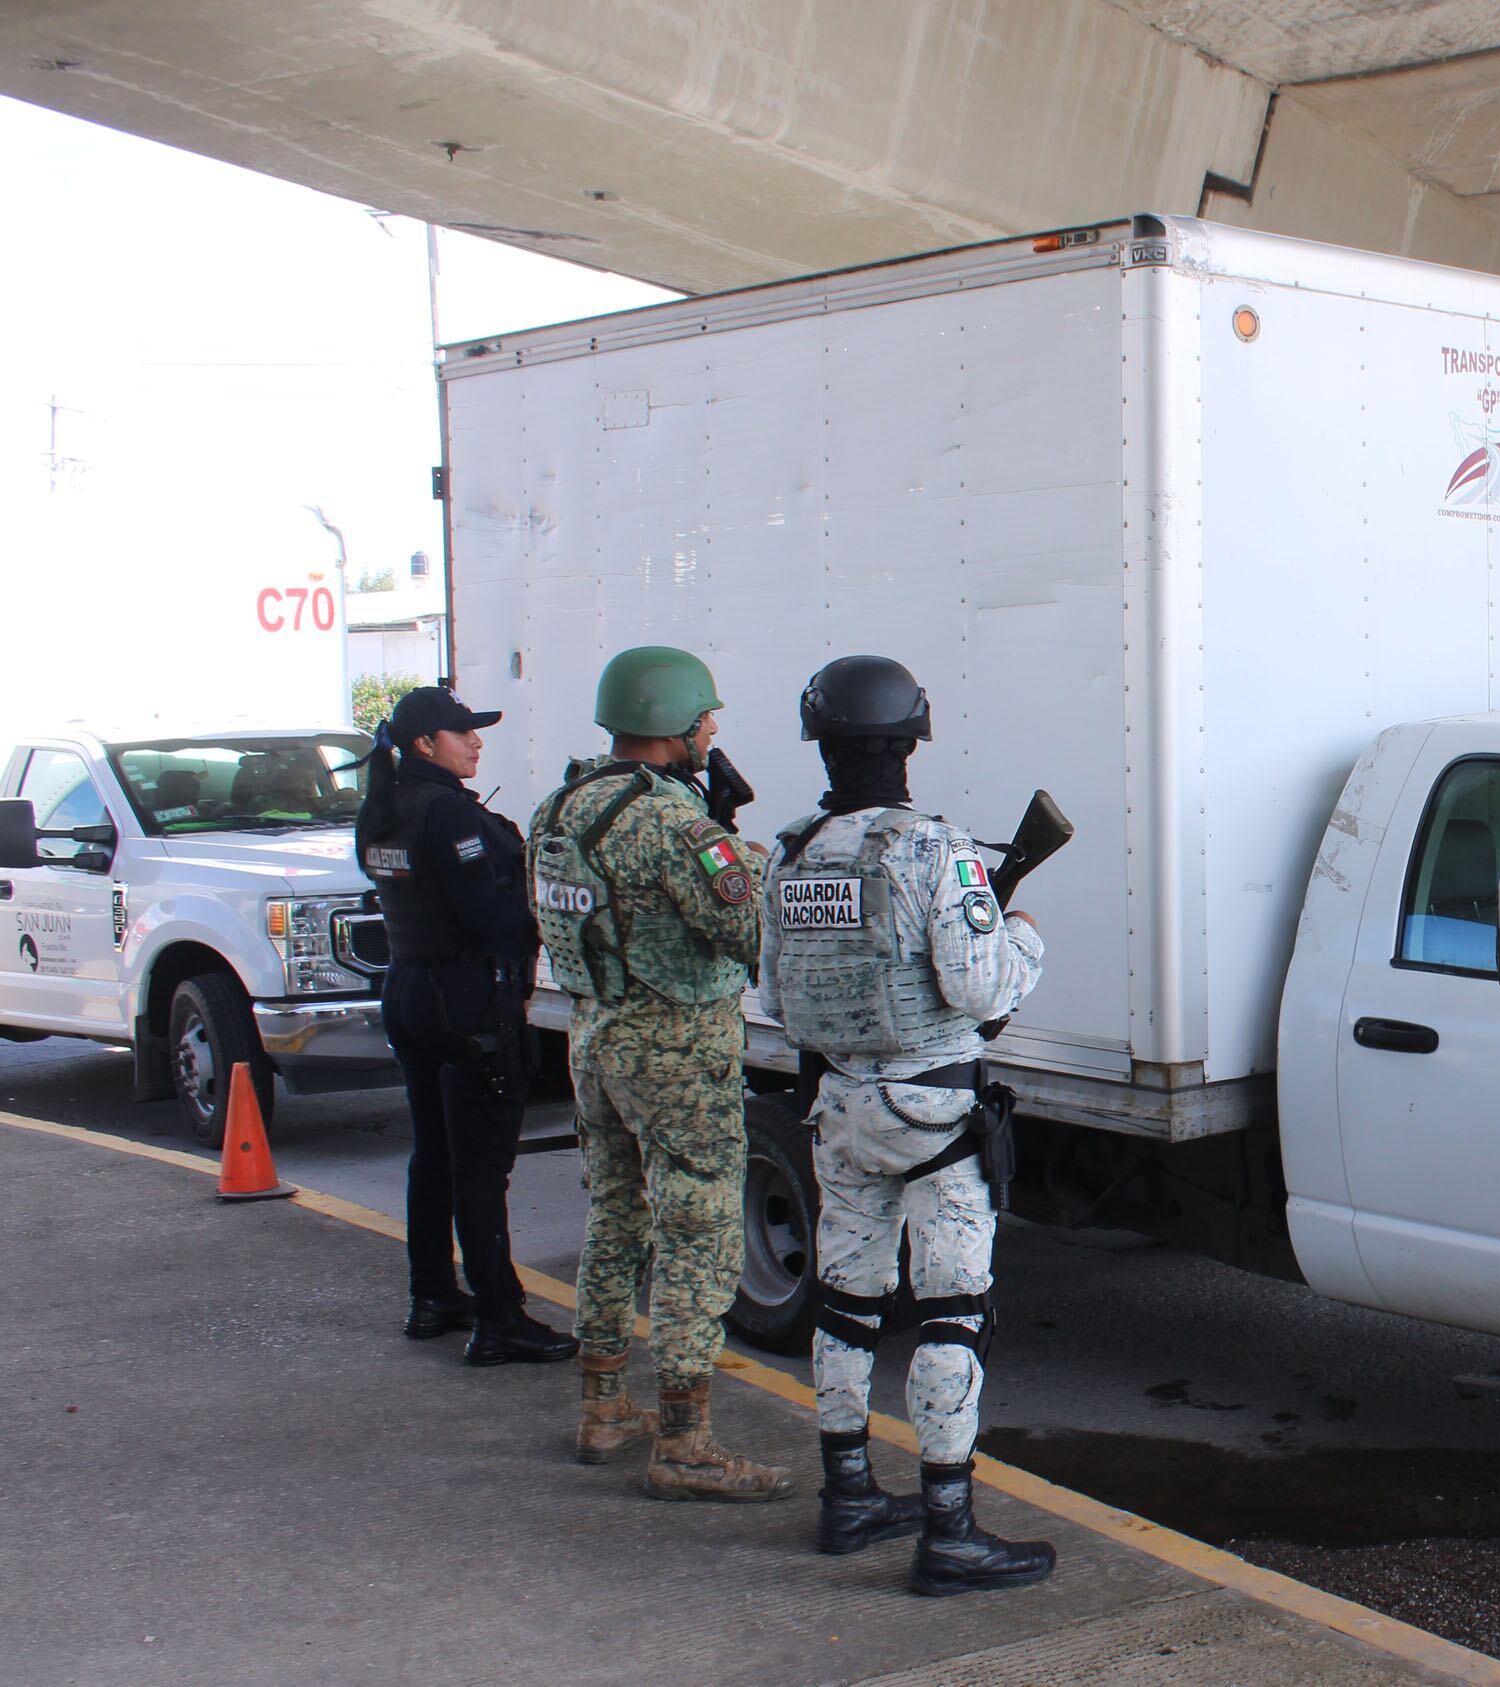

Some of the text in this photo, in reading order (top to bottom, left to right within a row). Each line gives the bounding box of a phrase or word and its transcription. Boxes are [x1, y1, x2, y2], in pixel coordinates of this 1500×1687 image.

[1437, 509, 1492, 521] COMPROMETIDOS
[256, 587, 335, 632] C70
[380, 848, 410, 869] ESTATAL
[537, 880, 593, 913] RCITO
[784, 882, 853, 903] GUARDIA
[16, 912, 71, 932] SAN JUAN
[783, 904, 859, 925] NACIONAL
